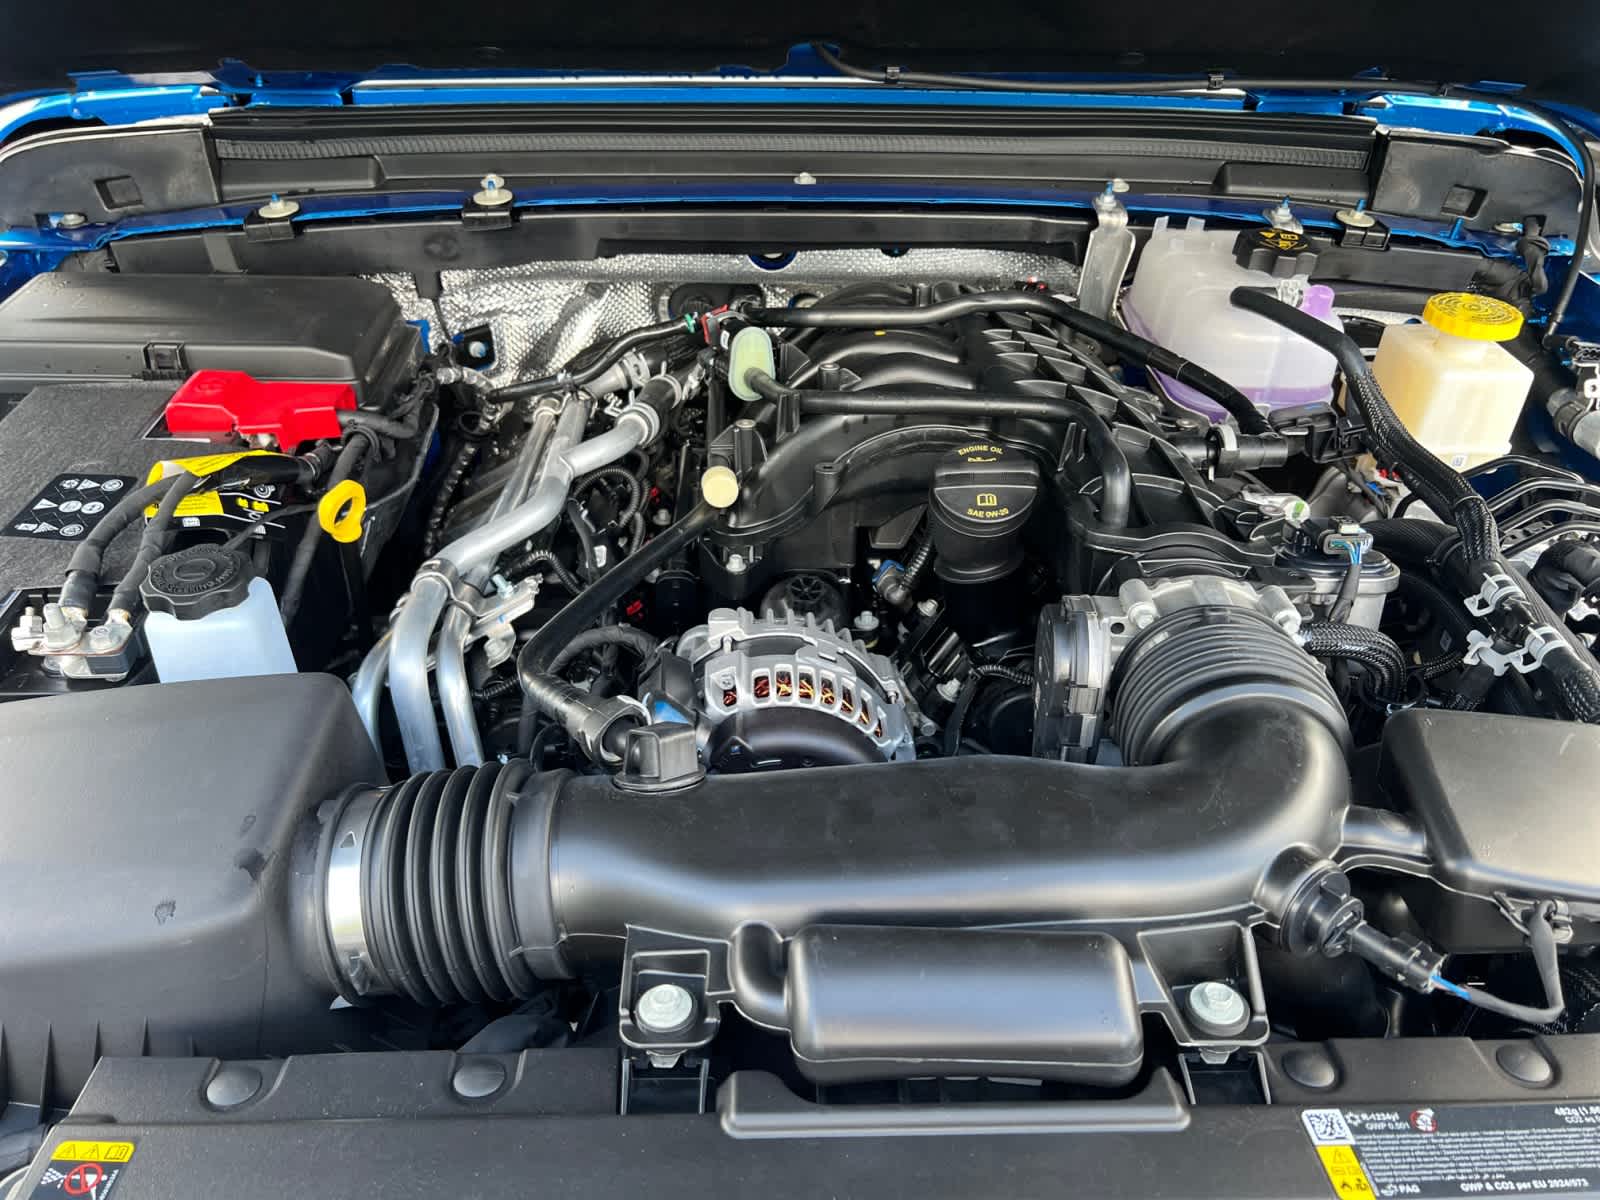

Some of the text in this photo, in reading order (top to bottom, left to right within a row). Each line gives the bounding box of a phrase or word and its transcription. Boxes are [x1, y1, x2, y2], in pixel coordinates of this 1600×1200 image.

[958, 444, 1004, 456] ENGINE OIL
[967, 507, 985, 518] SAE
[1398, 1183, 1421, 1194] PAG
[1460, 1182, 1484, 1193] GWP
[1494, 1180, 1516, 1191] CO2
[1532, 1178, 1548, 1190] EU
